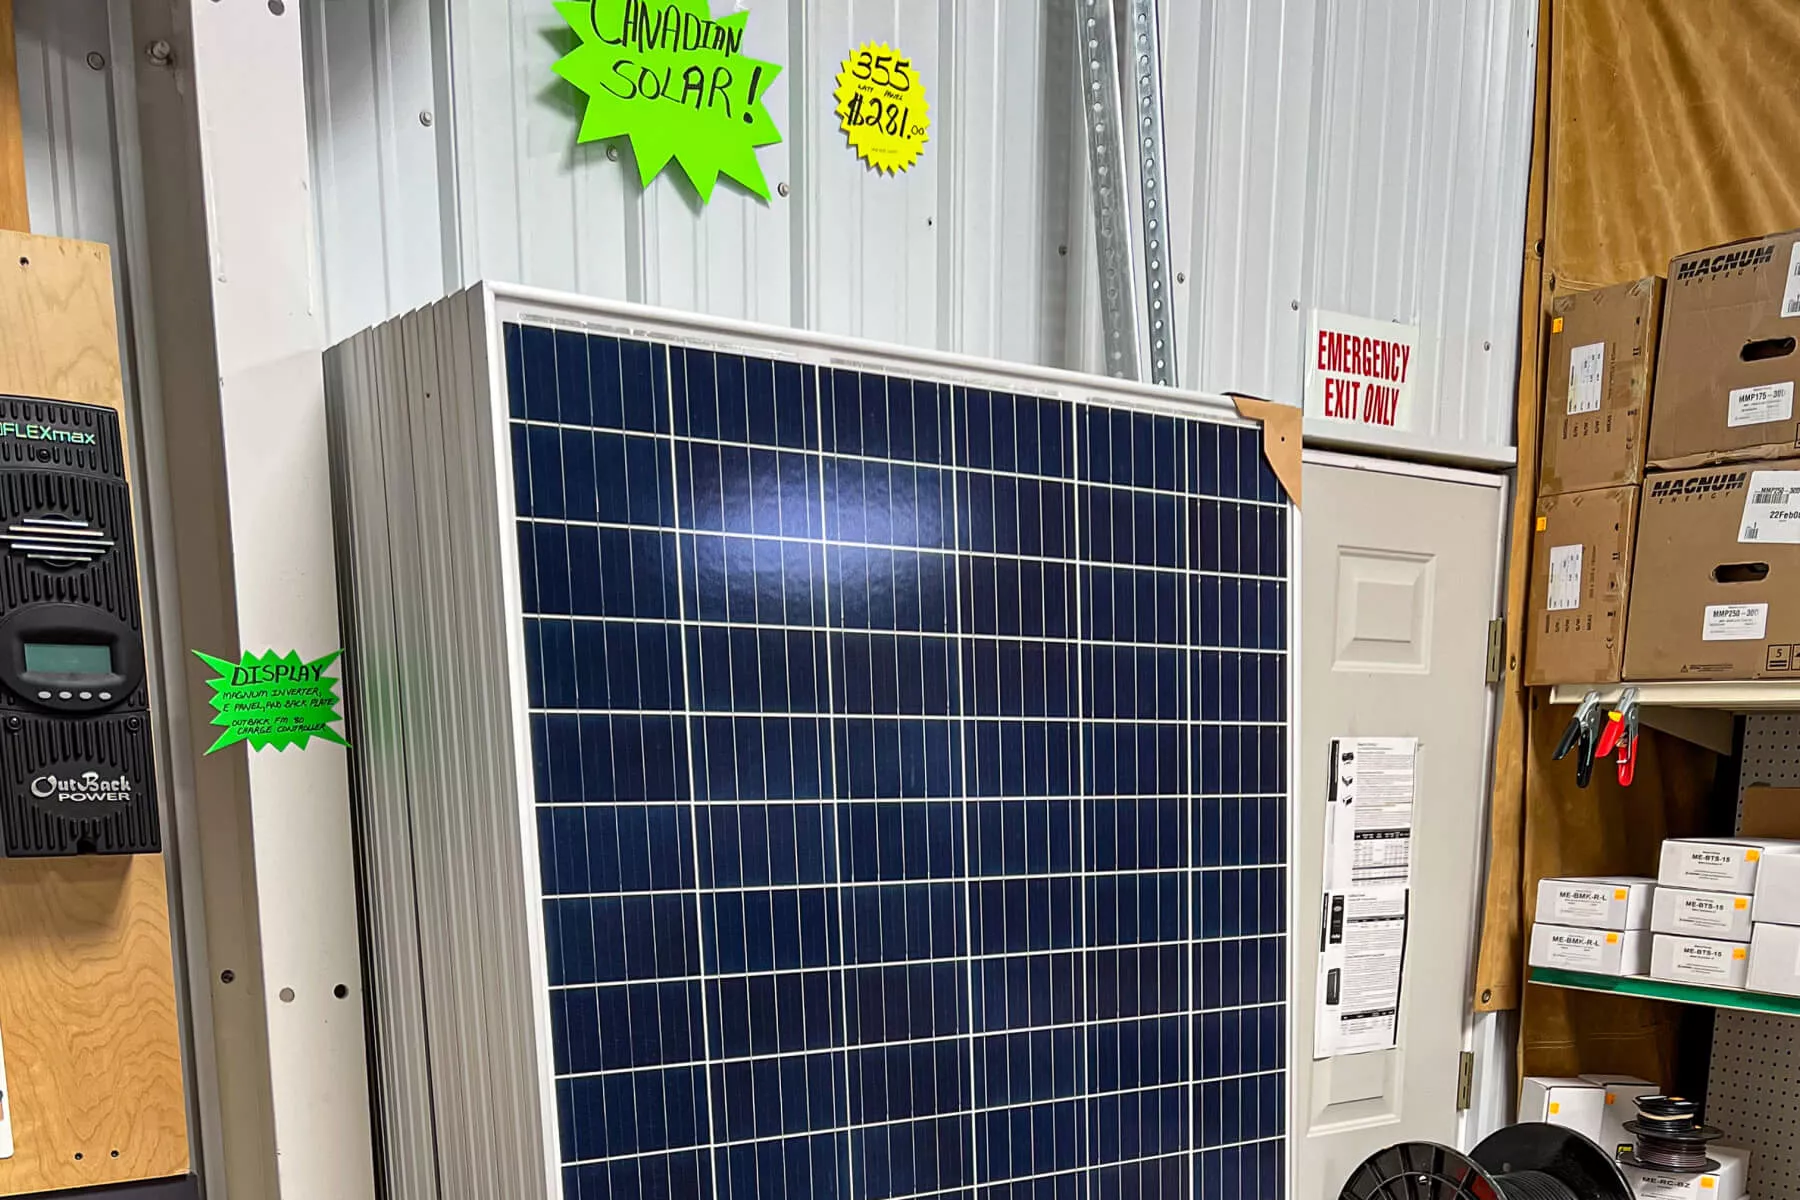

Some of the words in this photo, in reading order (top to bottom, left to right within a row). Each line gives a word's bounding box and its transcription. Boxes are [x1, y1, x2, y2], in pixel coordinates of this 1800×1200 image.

[590, 0, 742, 57] CANADIAN
[852, 51, 910, 91] 355
[1677, 245, 1775, 280] MAGNUM
[1318, 330, 1410, 383] EMERGENCY
[1325, 377, 1360, 420] EXIT
[1364, 383, 1400, 426] ONLY
[1651, 472, 1747, 498] MAGNUM
[231, 664, 323, 686] DISPLAY
[223, 690, 268, 700] MAGNUM
[223, 703, 229, 712] E
[236, 726, 272, 736] CHARGE
[30, 771, 131, 798] OutBack
[58, 792, 131, 802] POWER
